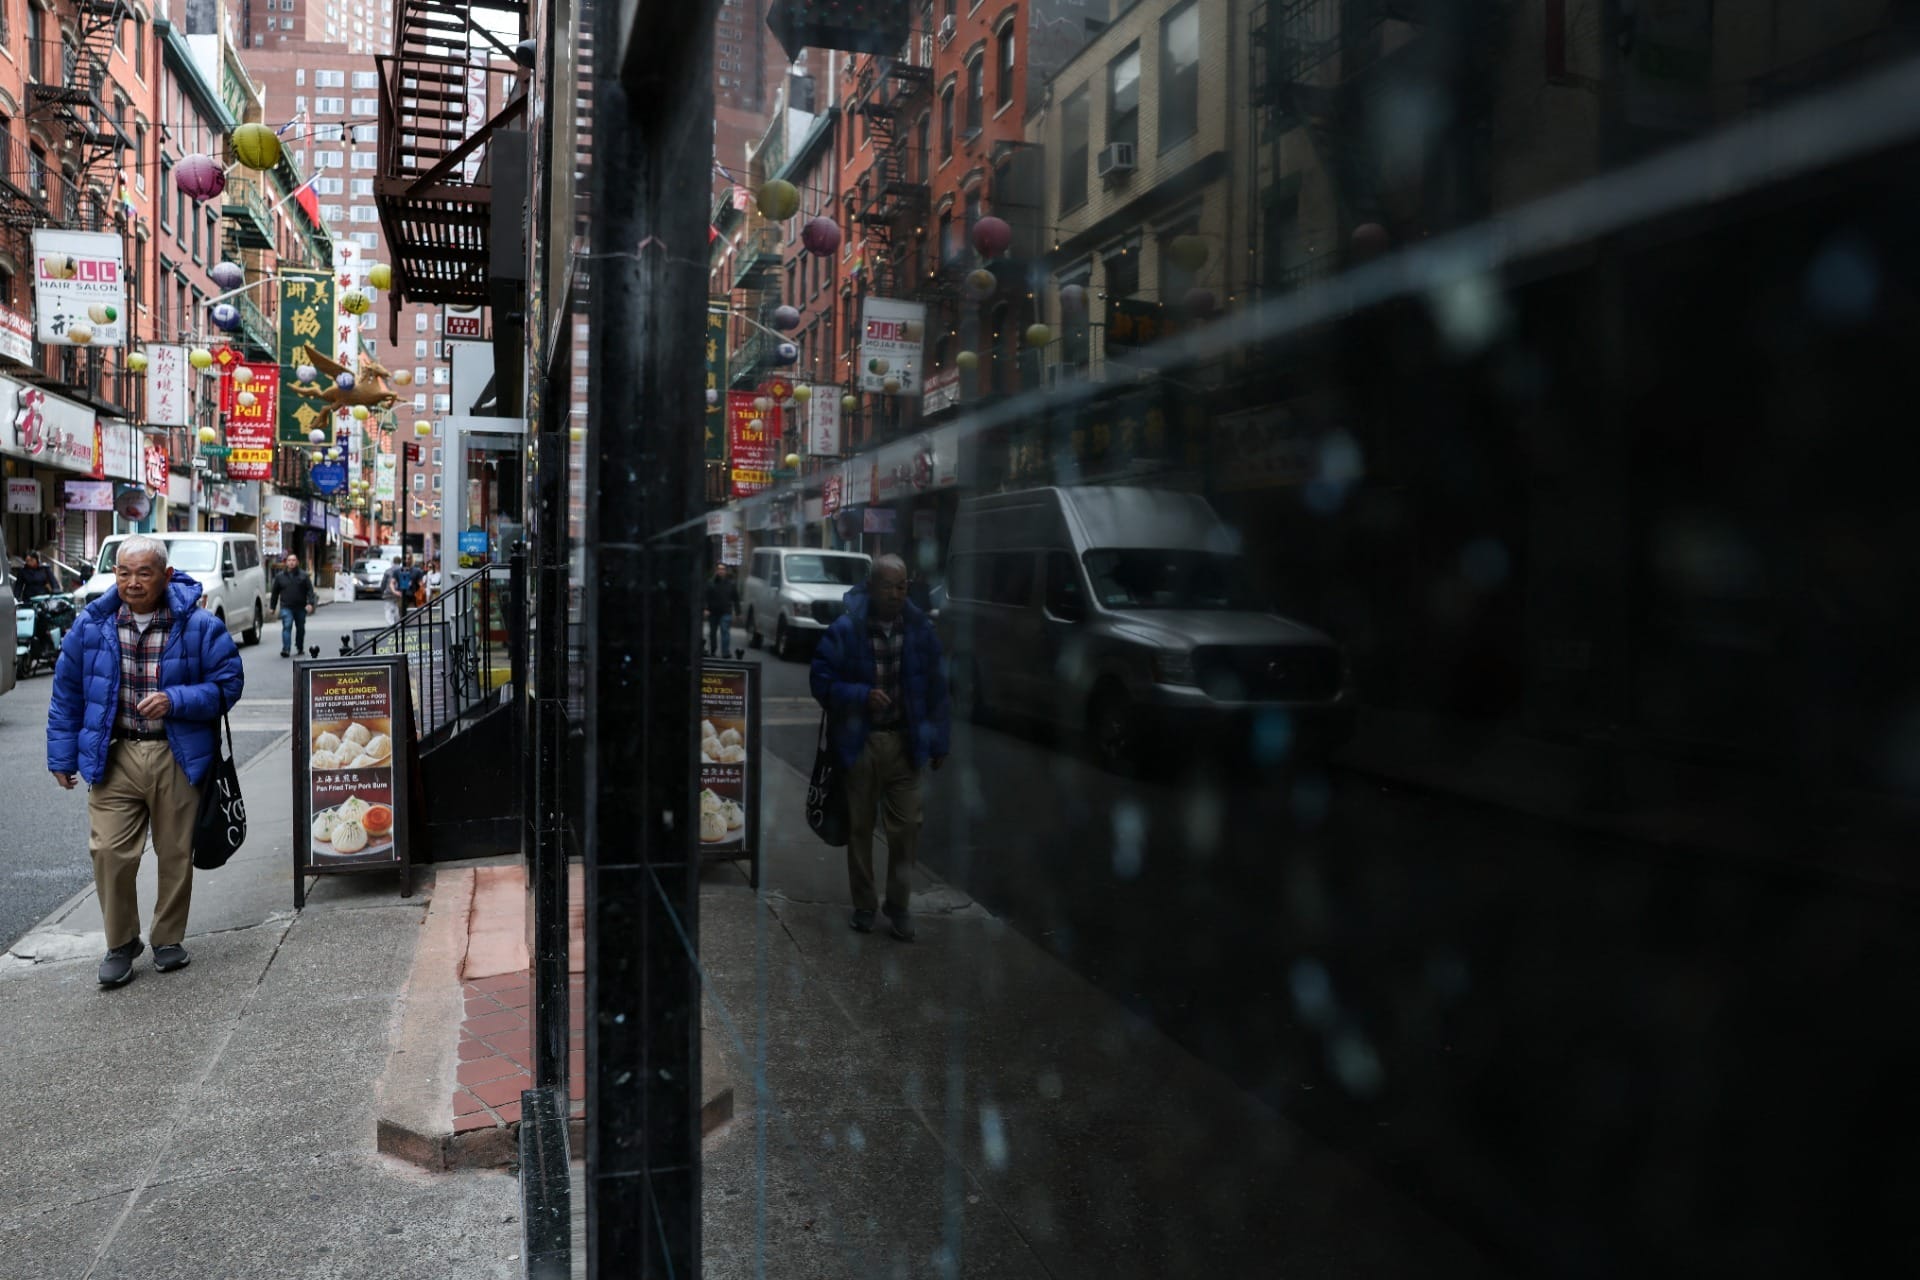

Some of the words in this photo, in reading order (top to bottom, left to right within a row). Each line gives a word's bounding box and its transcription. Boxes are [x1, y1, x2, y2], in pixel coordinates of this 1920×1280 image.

[41, 259, 115, 282] LL
[40, 280, 70, 289] HAIR
[76, 283, 118, 292] SALON
[234, 404, 262, 417] Pell
[337, 677, 364, 685] ZAGAT
[324, 687, 347, 696] JOE'S
[348, 686, 378, 694] GINGER
[345, 783, 357, 792] Tiny
